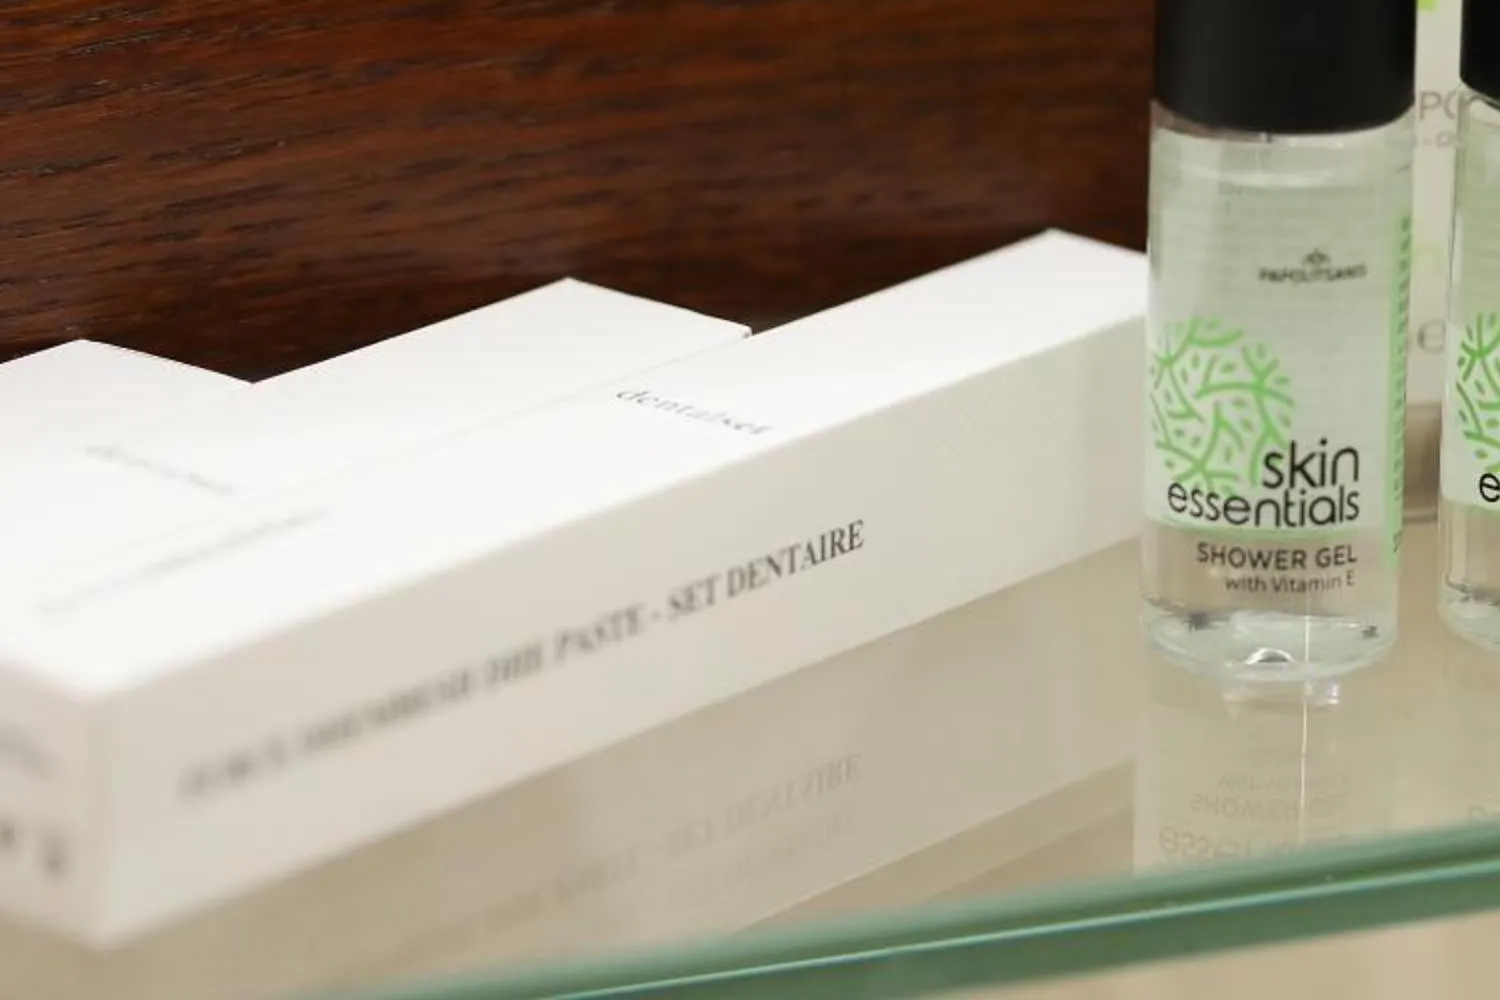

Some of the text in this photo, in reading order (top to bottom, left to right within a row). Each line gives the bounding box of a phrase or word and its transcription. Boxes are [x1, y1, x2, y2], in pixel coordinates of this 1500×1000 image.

[1263, 437, 1360, 489] skin
[1167, 482, 1360, 528] essentials
[666, 572, 722, 621] SET
[726, 519, 865, 600] DENTAIRE
[1196, 541, 1358, 571] SHOWER GEL
[1225, 569, 1355, 593] with Vitamin E
